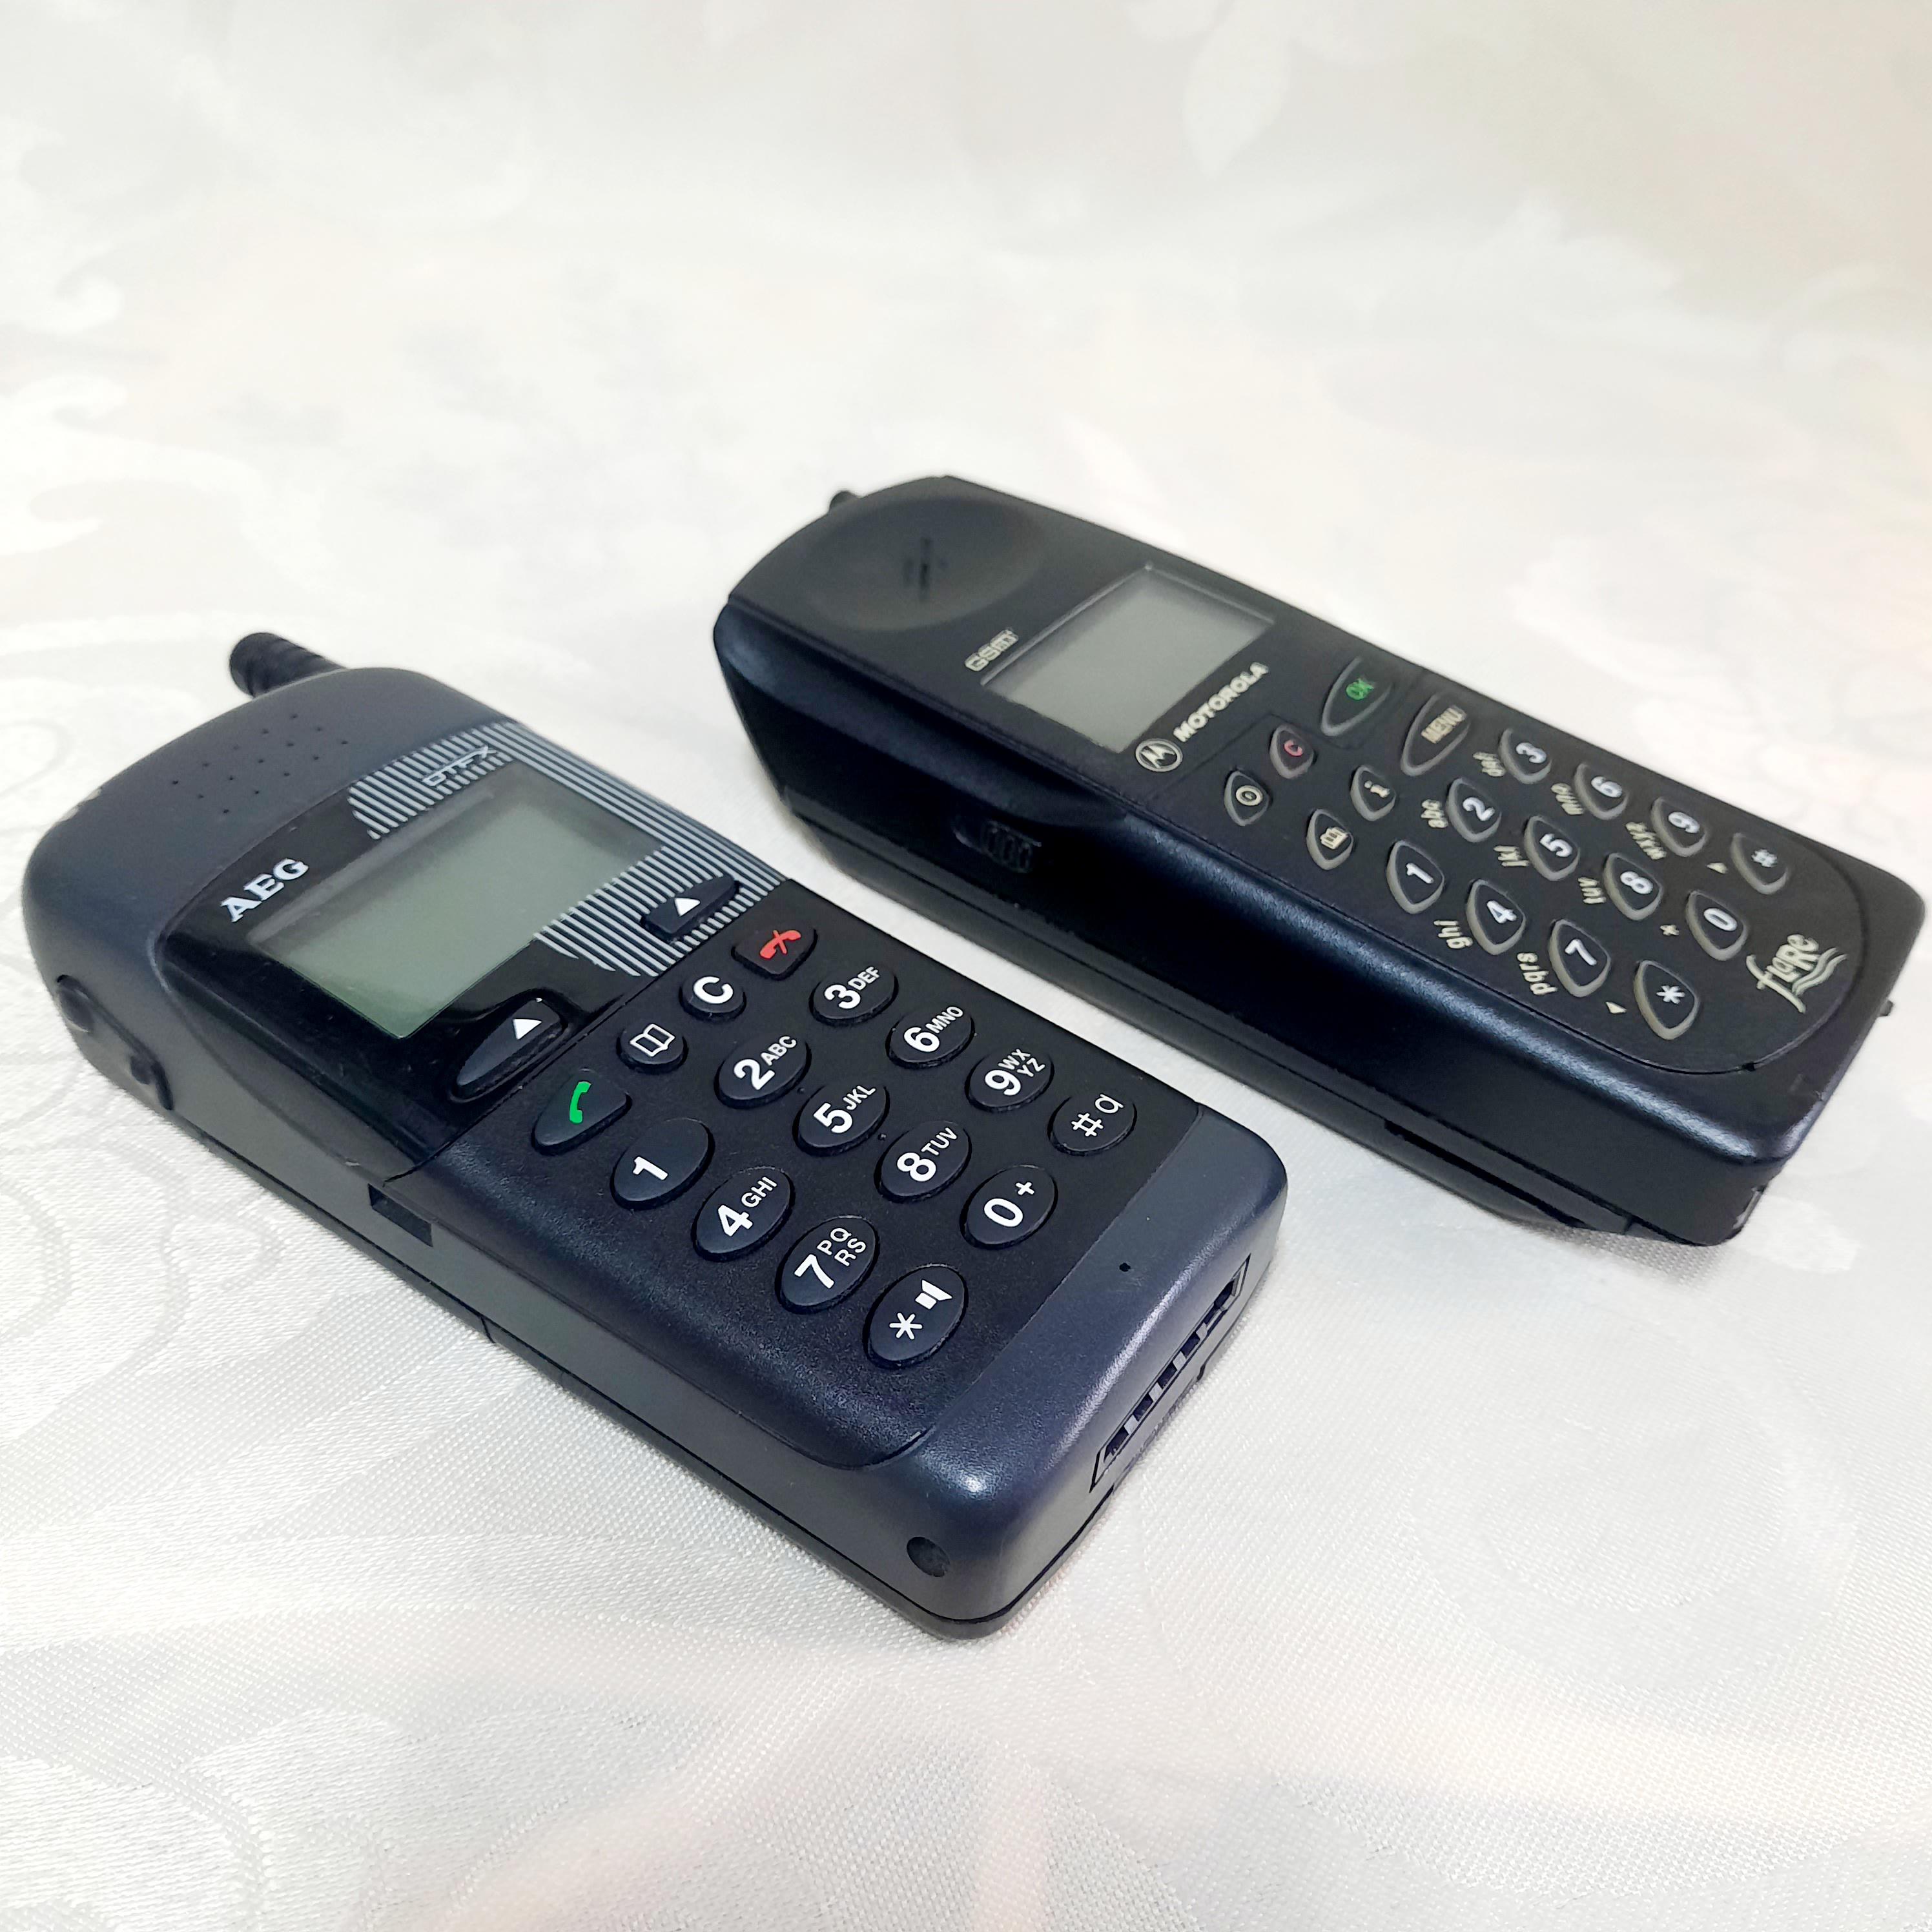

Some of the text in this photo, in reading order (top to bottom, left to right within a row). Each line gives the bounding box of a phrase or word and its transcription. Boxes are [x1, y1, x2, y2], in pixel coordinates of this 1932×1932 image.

[1173, 662, 1269, 742] MOTOROLA
[1421, 705, 1466, 743] MENU
[1284, 739, 1303, 756] C
[1516, 743, 1547, 763] 3
[1591, 776, 1623, 797] 6
[1421, 799, 1448, 828] abc
[1463, 797, 1494, 821] 2
[1668, 812, 1700, 833] 9
[1539, 834, 1572, 857] 5
[1406, 863, 1434, 884] 1
[1620, 871, 1652, 894] 8
[221, 858, 309, 922] AEG
[1486, 901, 1517, 923] 4
[1703, 908, 1737, 931] 0
[1434, 920, 1474, 949] ghi
[1565, 939, 1597, 965] 7
[1517, 952, 1557, 995] pqrs
[694, 976, 734, 1004] C
[824, 966, 879, 1009] 3 DEF
[903, 1006, 963, 1053] 6 MNO
[734, 1036, 797, 1090] 2 ABC
[998, 1049, 1031, 1071] WX
[1017, 1058, 1045, 1079] YZ
[985, 1069, 1021, 1096] 9
[813, 1085, 876, 1133] 5 JKL
[1071, 1113, 1104, 1136] #
[632, 1156, 668, 1180] 1
[897, 1127, 957, 1182] 8 TUV
[717, 1177, 777, 1237] 4 GHI
[983, 1198, 1023, 1227] 0
[817, 1228, 852, 1255] PQ
[834, 1238, 867, 1266] RS
[794, 1254, 834, 1289] 7
